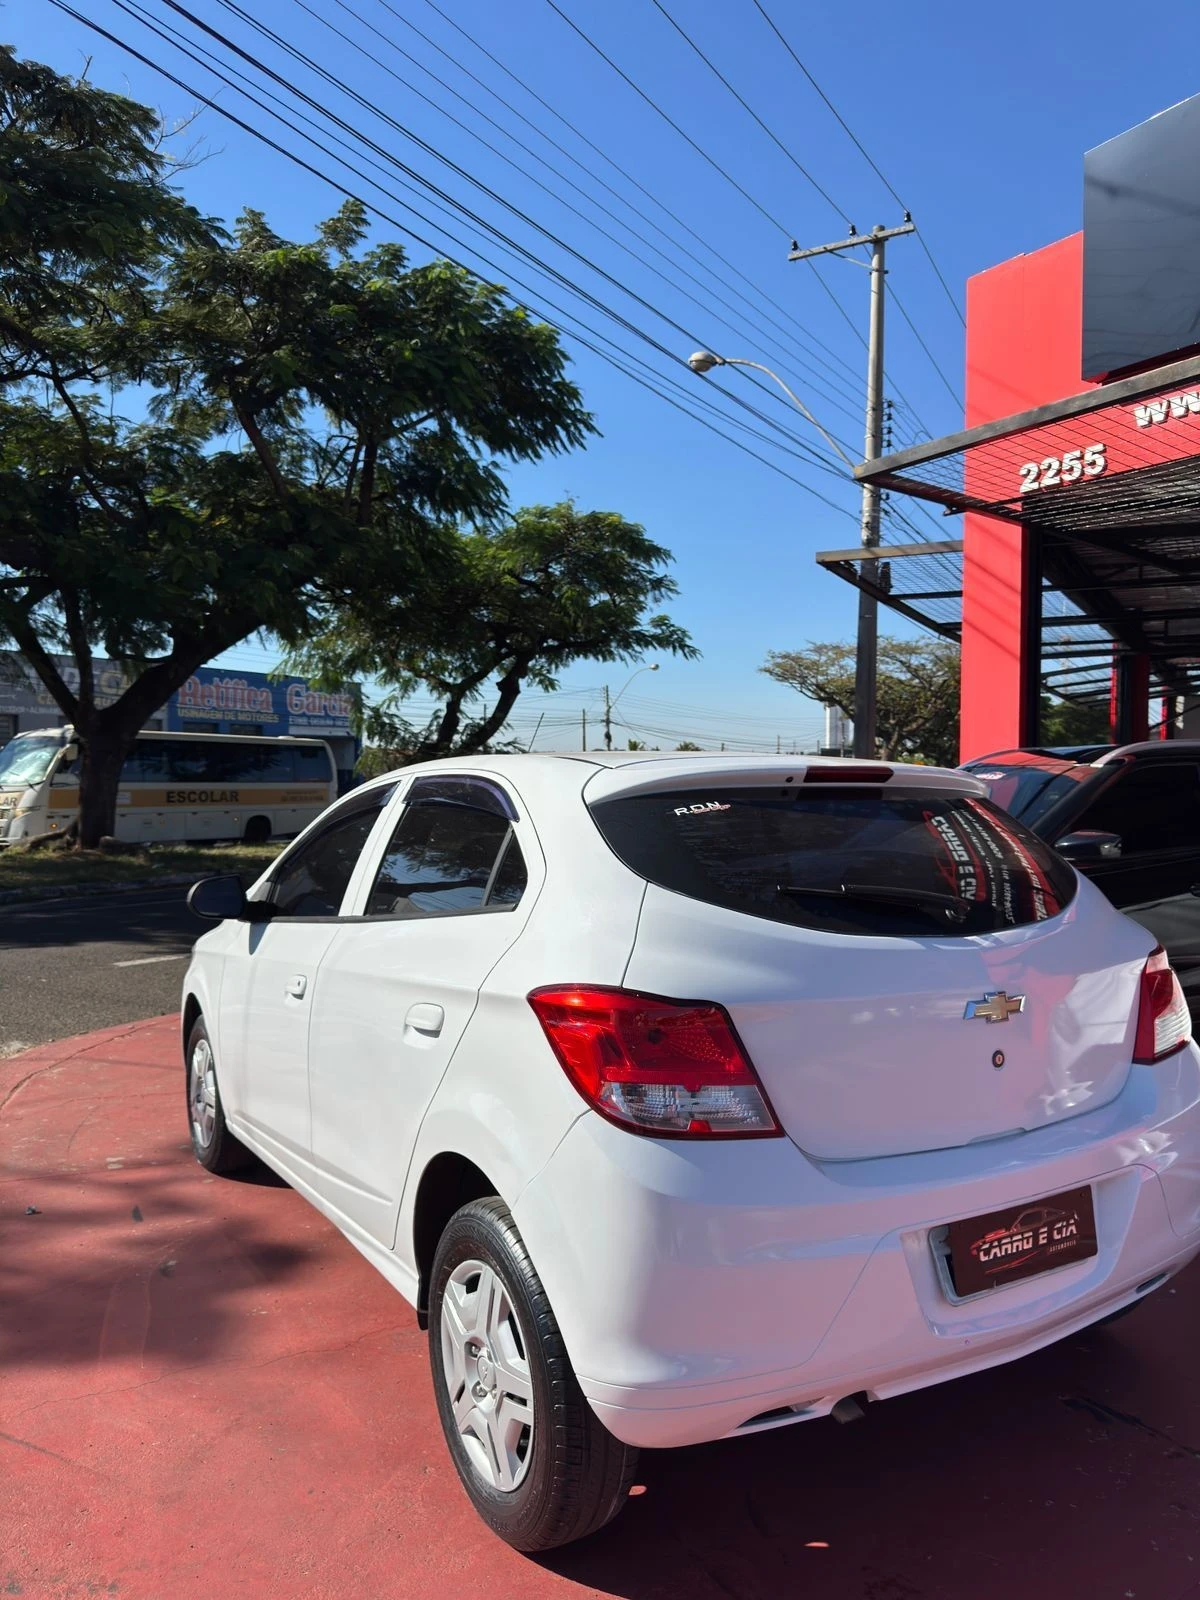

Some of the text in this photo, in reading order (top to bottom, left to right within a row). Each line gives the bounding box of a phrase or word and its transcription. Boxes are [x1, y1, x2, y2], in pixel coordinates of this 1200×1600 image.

[1020, 443, 1107, 493] 2255
[225, 711, 238, 720] DE
[166, 790, 239, 804] ESCOLAR
[979, 1219, 1077, 1262] CARRO E CIA
